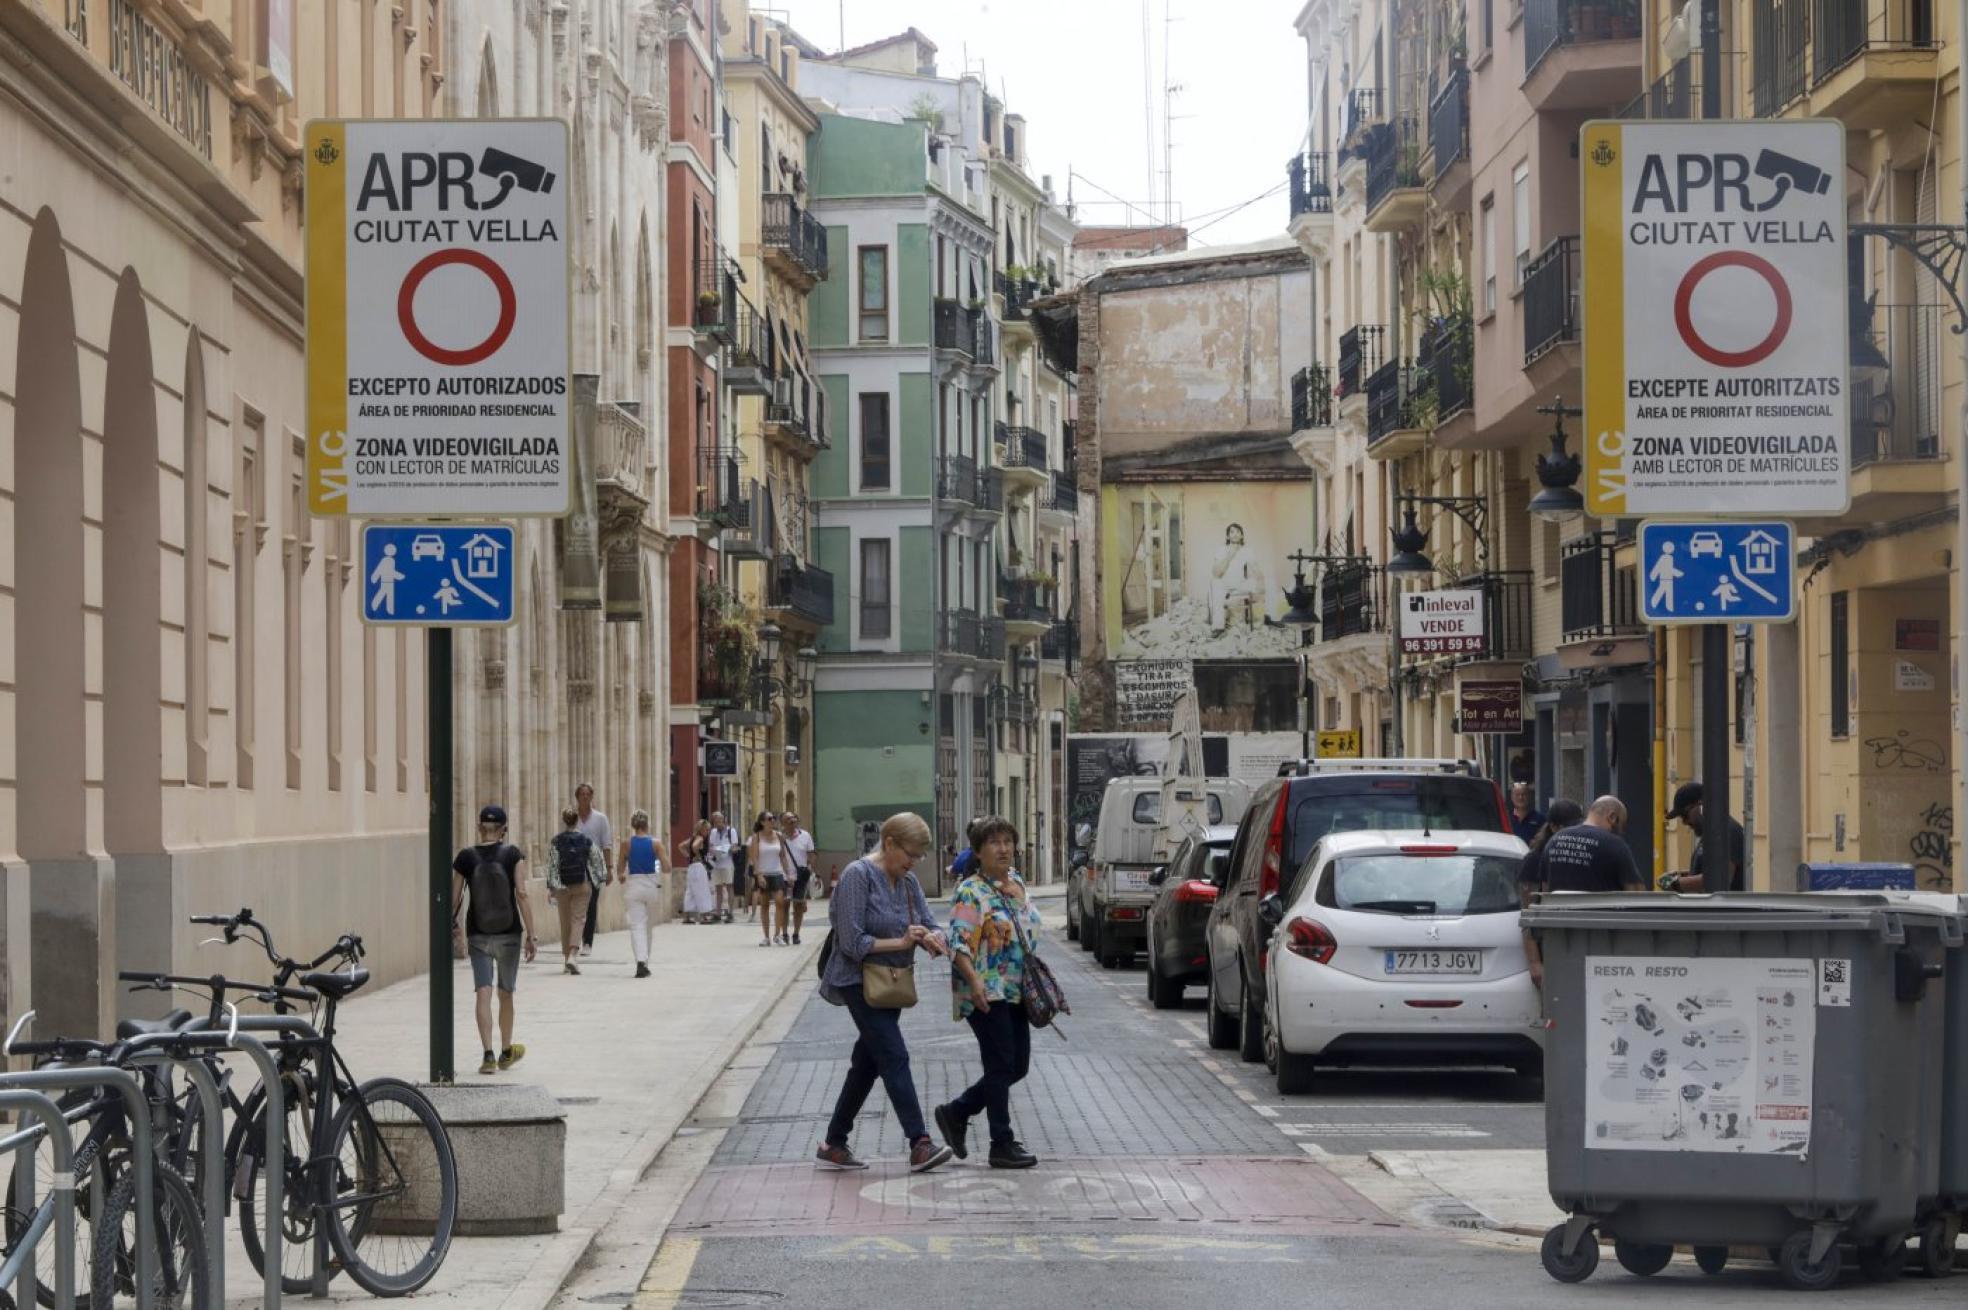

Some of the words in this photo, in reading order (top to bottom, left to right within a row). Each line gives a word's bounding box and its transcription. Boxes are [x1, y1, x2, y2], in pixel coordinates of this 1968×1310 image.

[356, 152, 479, 211] APR
[1631, 153, 1755, 213] APR
[354, 220, 459, 243] CIUTAT
[467, 219, 558, 242] VELLA
[1630, 221, 1736, 245] CIUTAT
[1743, 220, 1835, 243] VELLA
[348, 377, 431, 396] EXCEPTO
[436, 377, 566, 396] AUTORIZADOS
[1628, 379, 1708, 398] EXCEPTE
[1714, 377, 1840, 397] AUTORITZATS
[358, 403, 391, 416] ÁREA
[393, 405, 409, 416] DE
[412, 404, 476, 416] PRIORIDAD
[479, 404, 556, 416] RESIDENCIAL
[1672, 406, 1687, 418] DE
[1690, 405, 1752, 418] PRIORITAT
[1755, 404, 1833, 417] RESIDENCIAL
[356, 438, 407, 457] ZONA
[412, 438, 560, 456] VIDEOVIGILADA
[1632, 437, 1684, 456] ZONA
[1690, 435, 1838, 455] VIDEOVIGILADA
[320, 431, 347, 502] VLC
[356, 460, 386, 475] CON
[390, 460, 444, 475] LECTOR
[449, 459, 466, 474] DE
[471, 456, 559, 474] MATRÍCULAS
[1598, 431, 1625, 502] VLC
[1632, 459, 1664, 474] AMB
[1669, 458, 1723, 474] LECTOR
[1727, 458, 1746, 473] DE
[1750, 454, 1839, 472] MATRÍCULES
[1426, 596, 1474, 612] inleval
[1420, 619, 1464, 633] VENDE
[1405, 640, 1420, 651] 96
[1423, 639, 1443, 651] 391
[1448, 638, 1463, 650] 59
[1466, 637, 1481, 649] 94
[1137, 671, 1171, 681] TIRAR
[1484, 710, 1497, 719] en
[1503, 707, 1520, 719] Art
[1397, 953, 1441, 968] 7713
[1445, 953, 1476, 968] JGV
[1593, 966, 1636, 977] RESTA
[1645, 966, 1688, 978] RESTO
